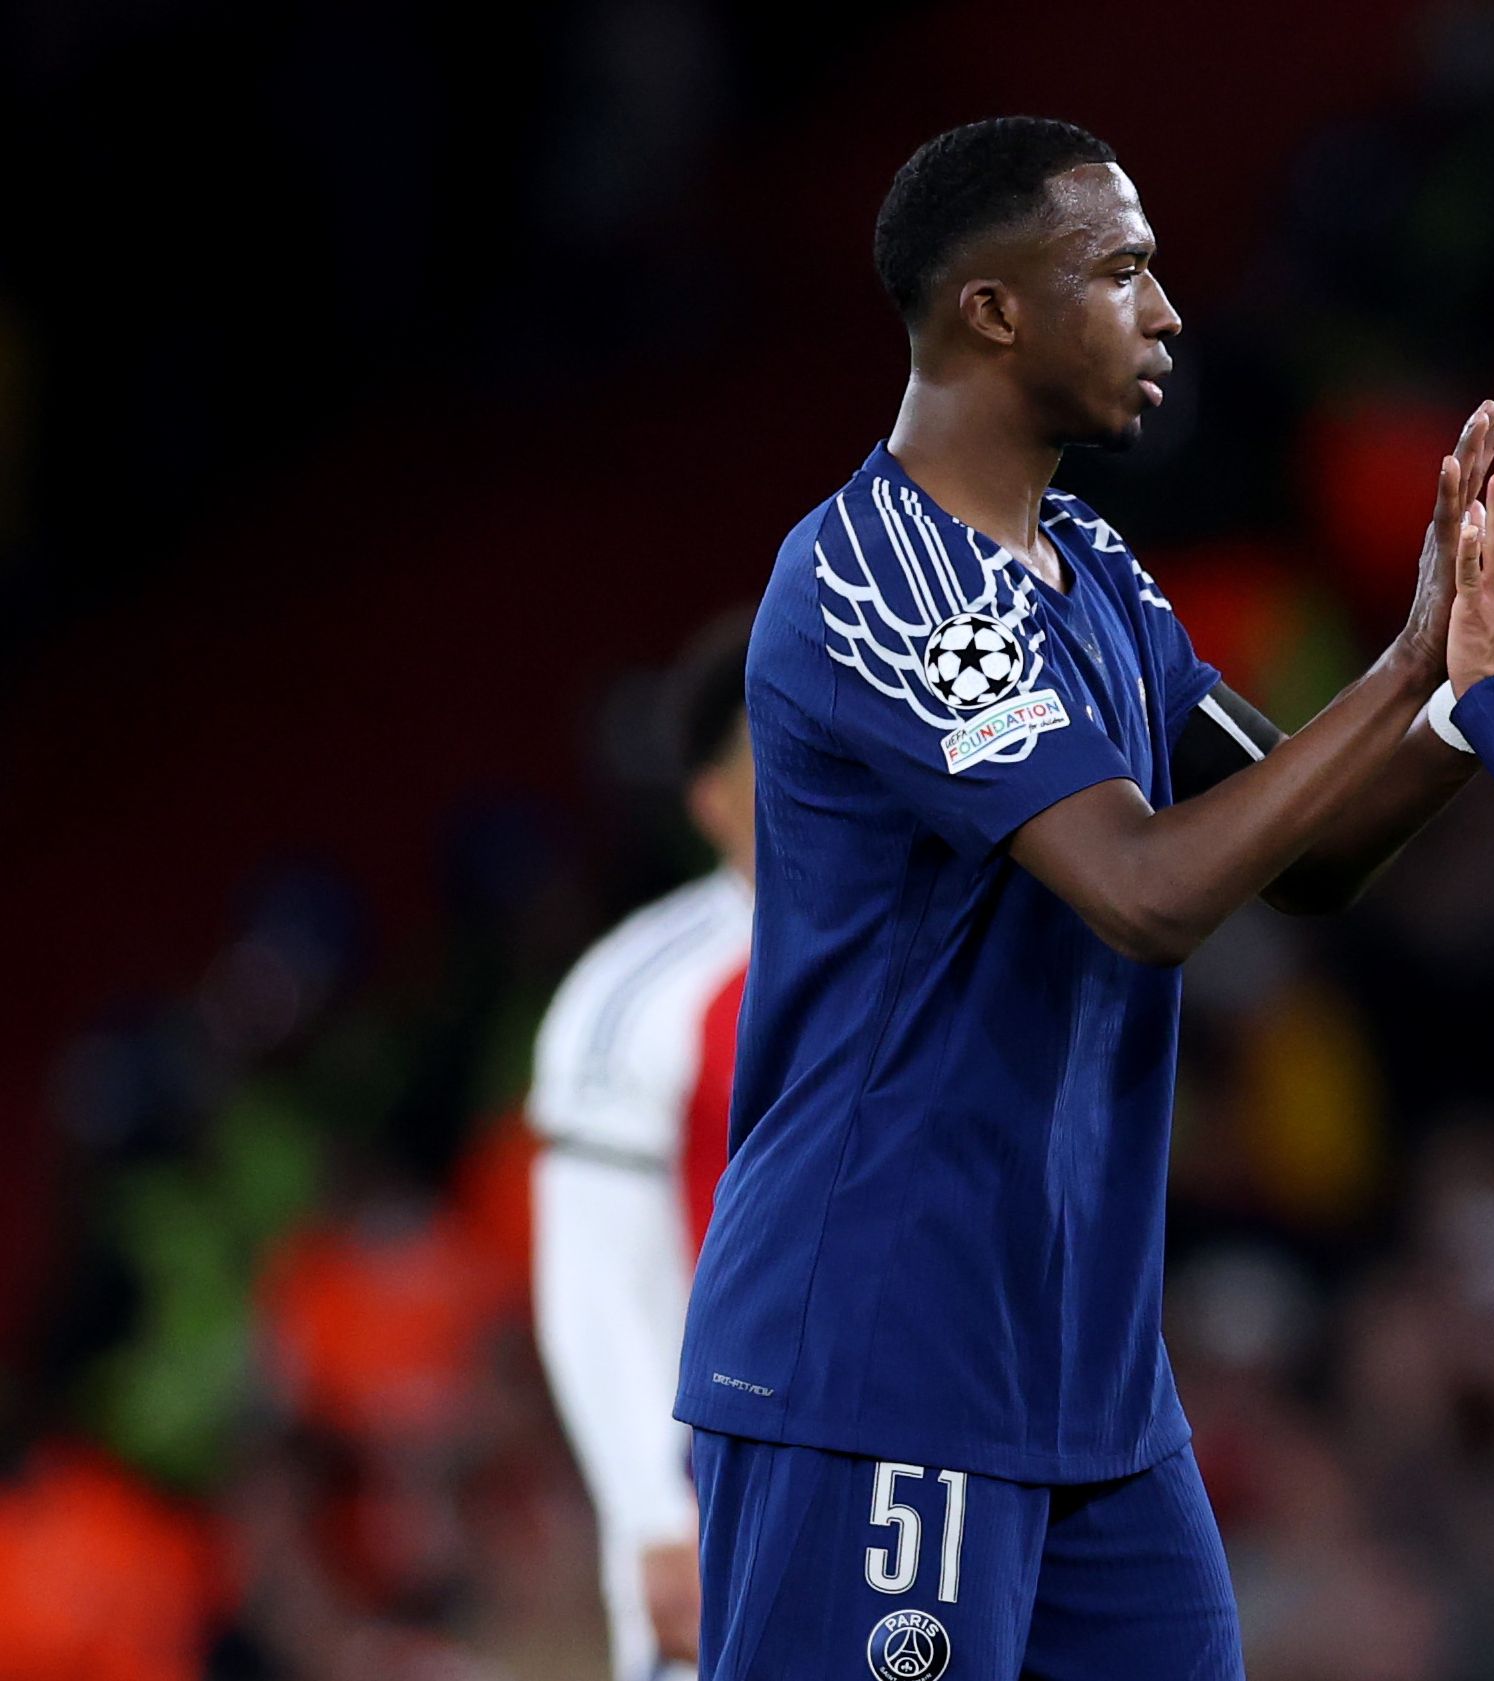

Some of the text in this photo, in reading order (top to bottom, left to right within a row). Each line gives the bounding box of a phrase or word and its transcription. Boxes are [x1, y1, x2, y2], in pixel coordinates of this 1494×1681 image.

[945, 730, 967, 748] UEFA
[865, 1461, 967, 1603] 51
[885, 1614, 939, 1637] PARIS
